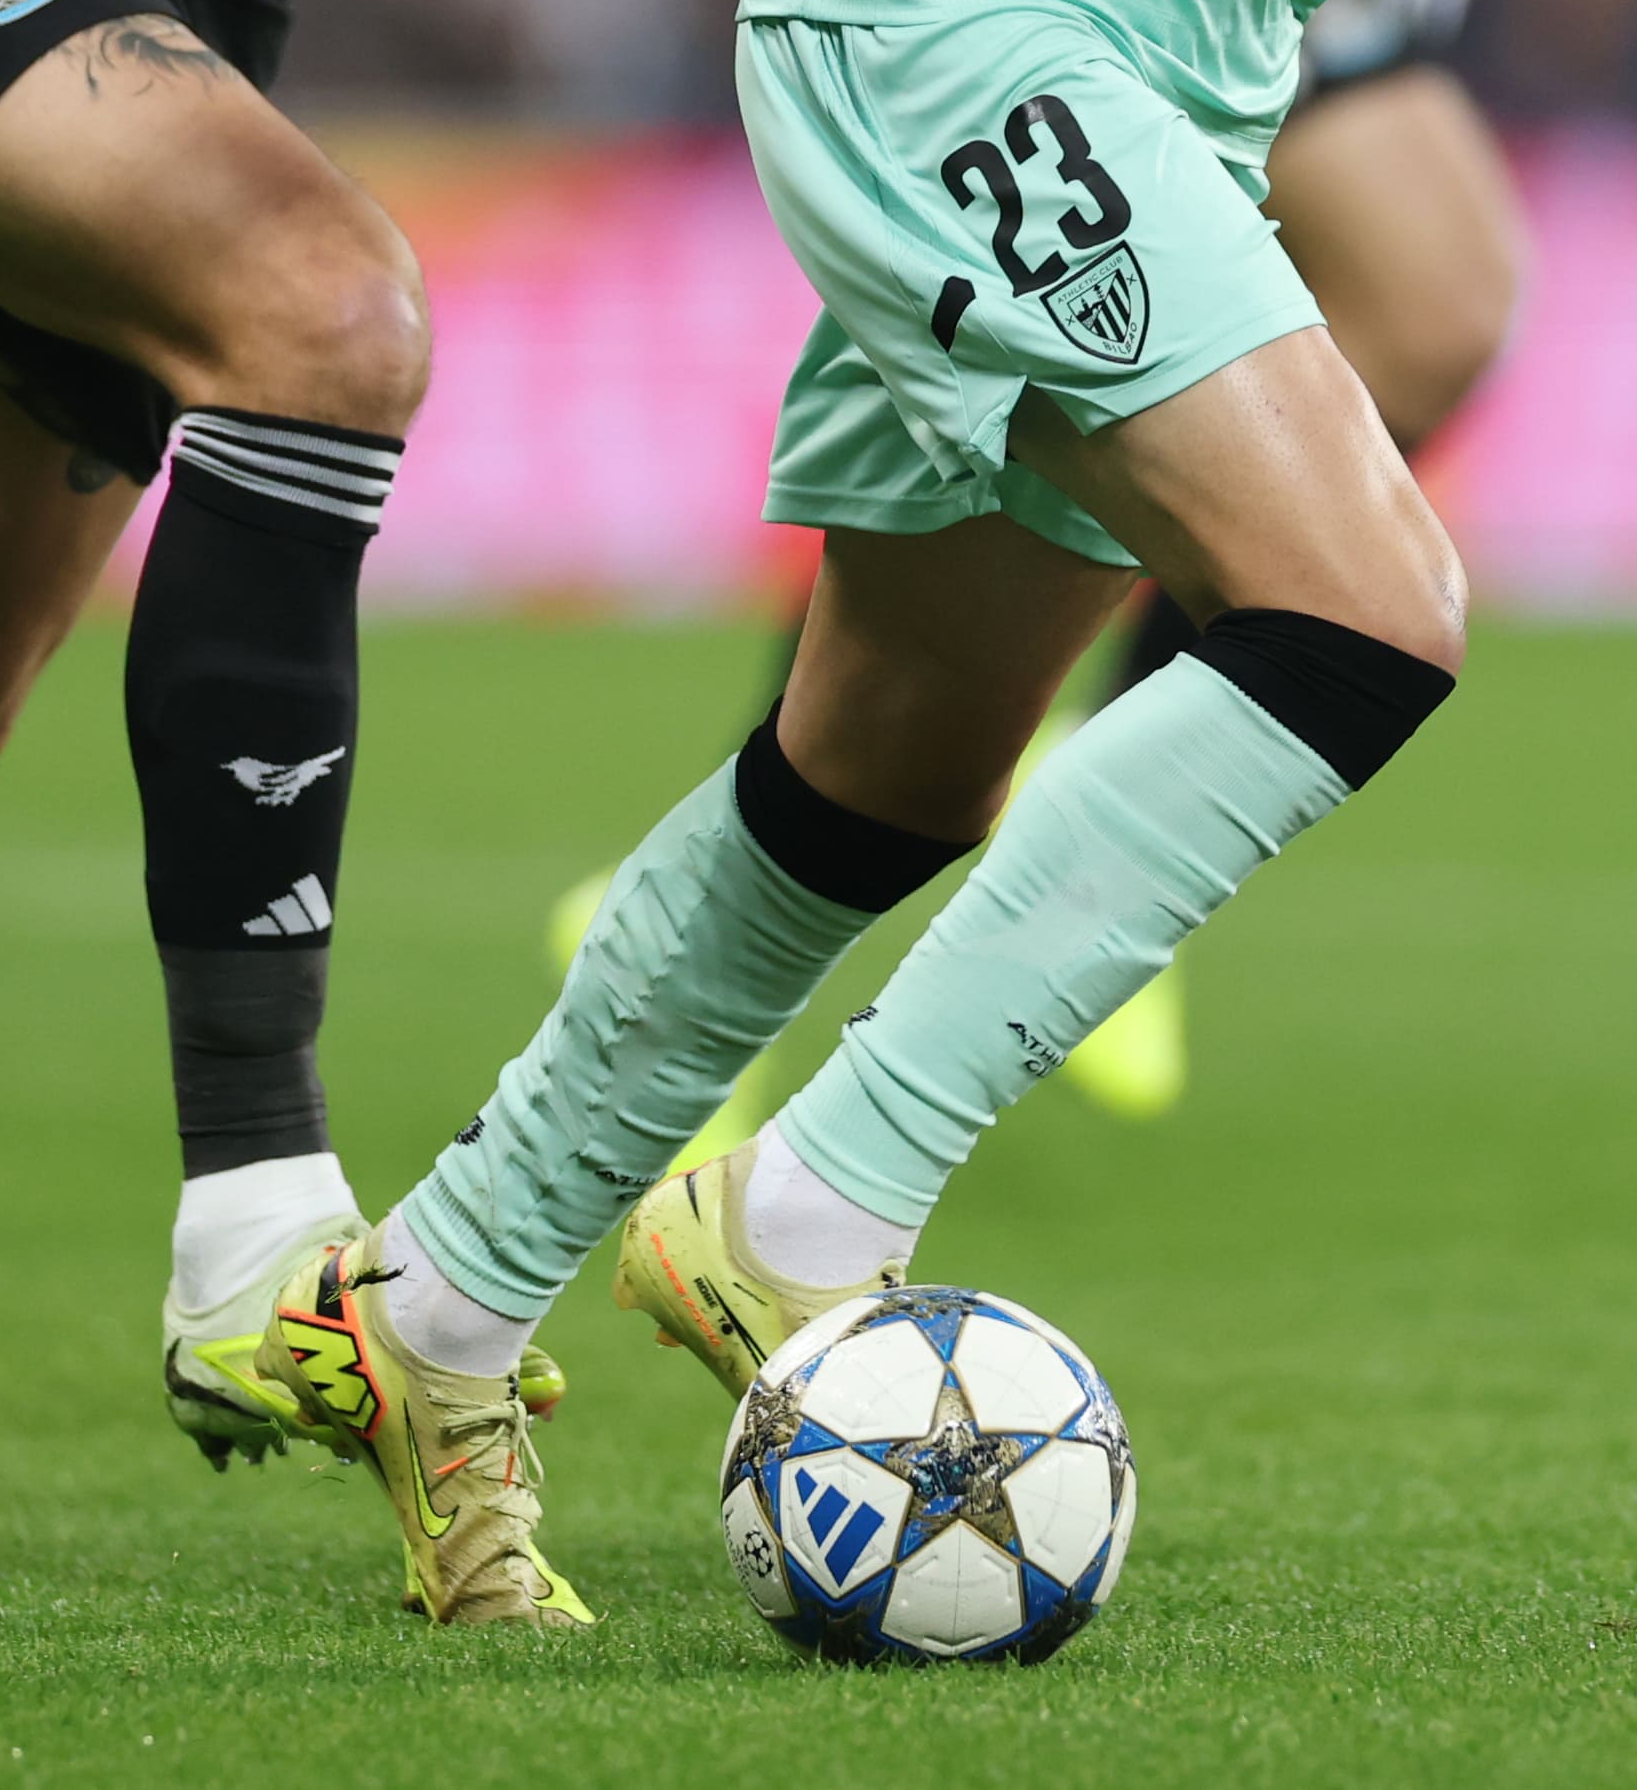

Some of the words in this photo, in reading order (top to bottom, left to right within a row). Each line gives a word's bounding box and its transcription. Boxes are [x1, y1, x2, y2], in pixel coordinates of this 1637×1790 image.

[941, 94, 1132, 298] 23
[1057, 273, 1099, 304] ATHLETIC
[1099, 256, 1124, 275] CLUB
[1102, 322, 1138, 355] BILBAO
